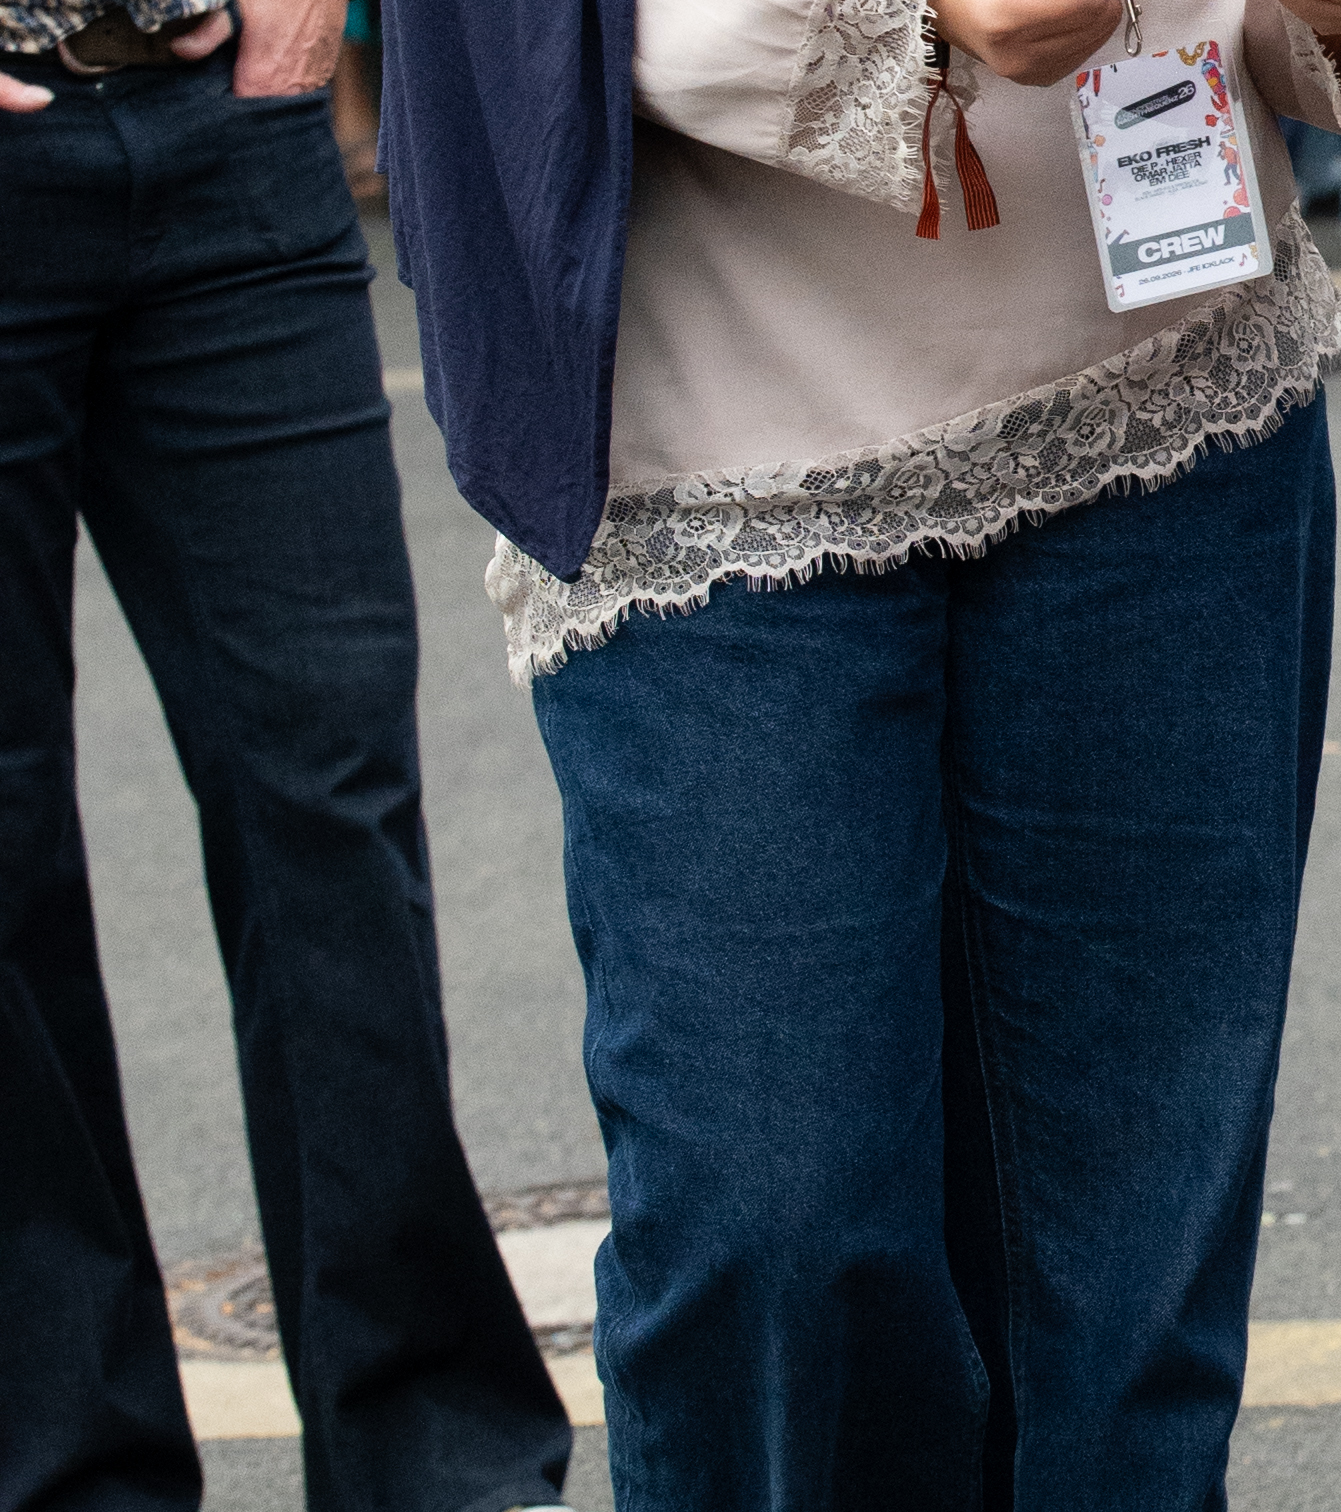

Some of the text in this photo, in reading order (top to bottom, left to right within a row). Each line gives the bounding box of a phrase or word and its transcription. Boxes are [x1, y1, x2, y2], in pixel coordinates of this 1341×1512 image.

[1177, 83, 1195, 99] 26
[1117, 135, 1211, 169] EKO FRESH
[1131, 151, 1202, 176] DIE P HEXER
[1134, 160, 1202, 183] OMAR JATTA
[1149, 170, 1190, 187] EM DEE
[1137, 224, 1226, 264] CREW
[1138, 269, 1182, 285] 26.09.2026
